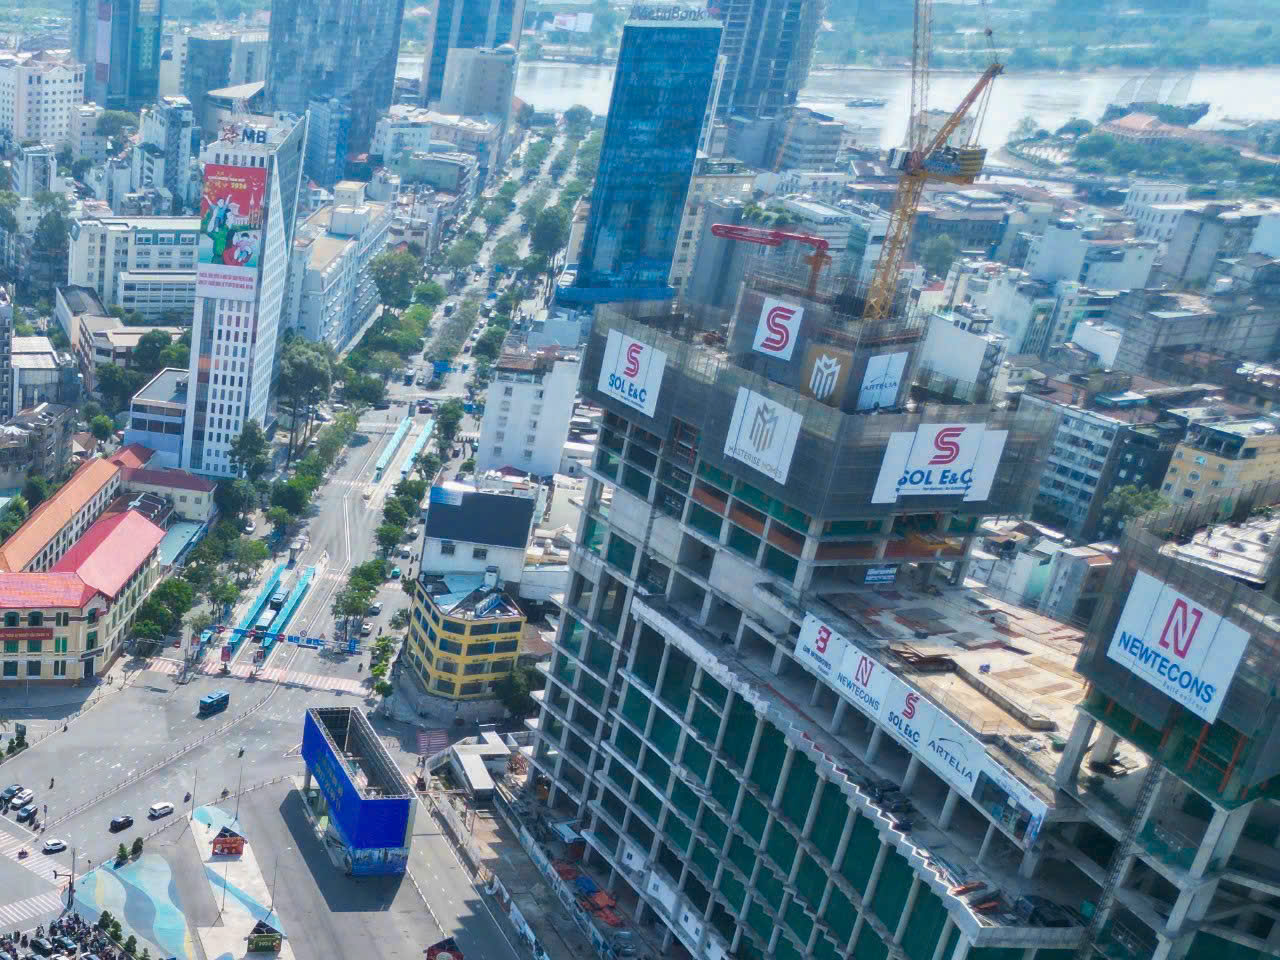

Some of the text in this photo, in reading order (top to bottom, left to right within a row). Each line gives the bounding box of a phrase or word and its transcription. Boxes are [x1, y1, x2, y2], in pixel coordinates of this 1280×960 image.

[241, 128, 267, 144] MB
[608, 373, 625, 393] SOL
[628, 383, 647, 402] E&C
[897, 468, 973, 486] SOL E&C
[1118, 631, 1215, 703] NEWTECONS
[837, 672, 880, 711] NEWTECONS
[888, 711, 903, 730] SOL
[904, 726, 920, 742] E&C
[928, 740, 973, 782] ARTELIA
